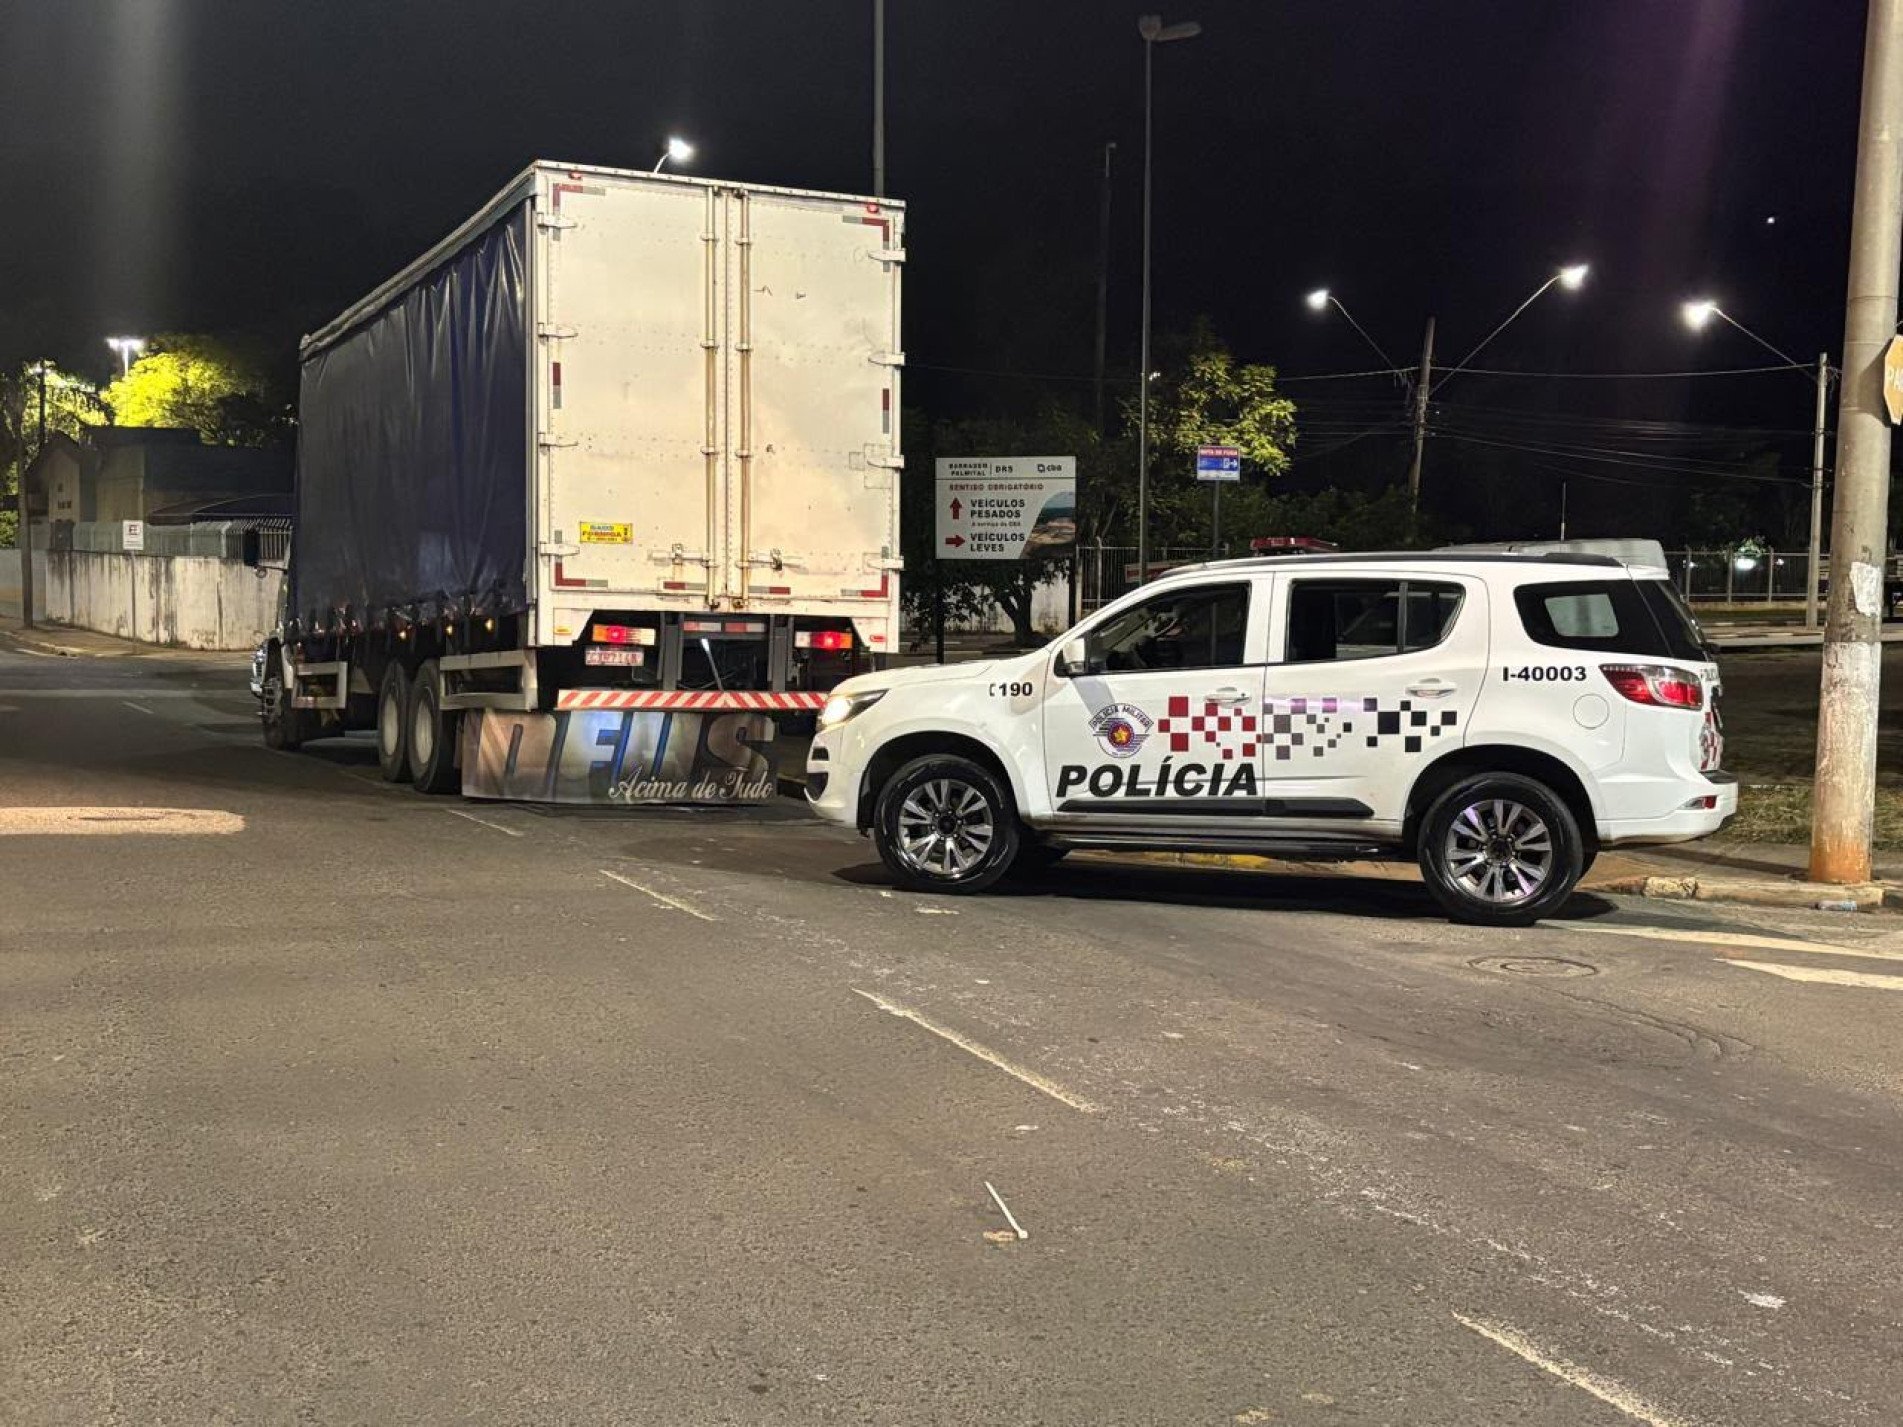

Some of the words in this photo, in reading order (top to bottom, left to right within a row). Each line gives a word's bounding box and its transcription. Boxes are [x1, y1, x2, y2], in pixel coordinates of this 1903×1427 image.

[949, 483, 984, 491] SENTIDO
[970, 498, 1025, 508] VEÍCULOS
[970, 509, 1021, 518] PESADOS
[970, 532, 1025, 542] VEÍCULOS
[970, 544, 1004, 552] LEVES
[1503, 666, 1587, 682] I-40003
[999, 682, 1033, 697] 190
[1056, 755, 1258, 798] POLÍCIA
[608, 765, 688, 803] Acima
[691, 771, 716, 799] de
[719, 770, 774, 799] Tudo
